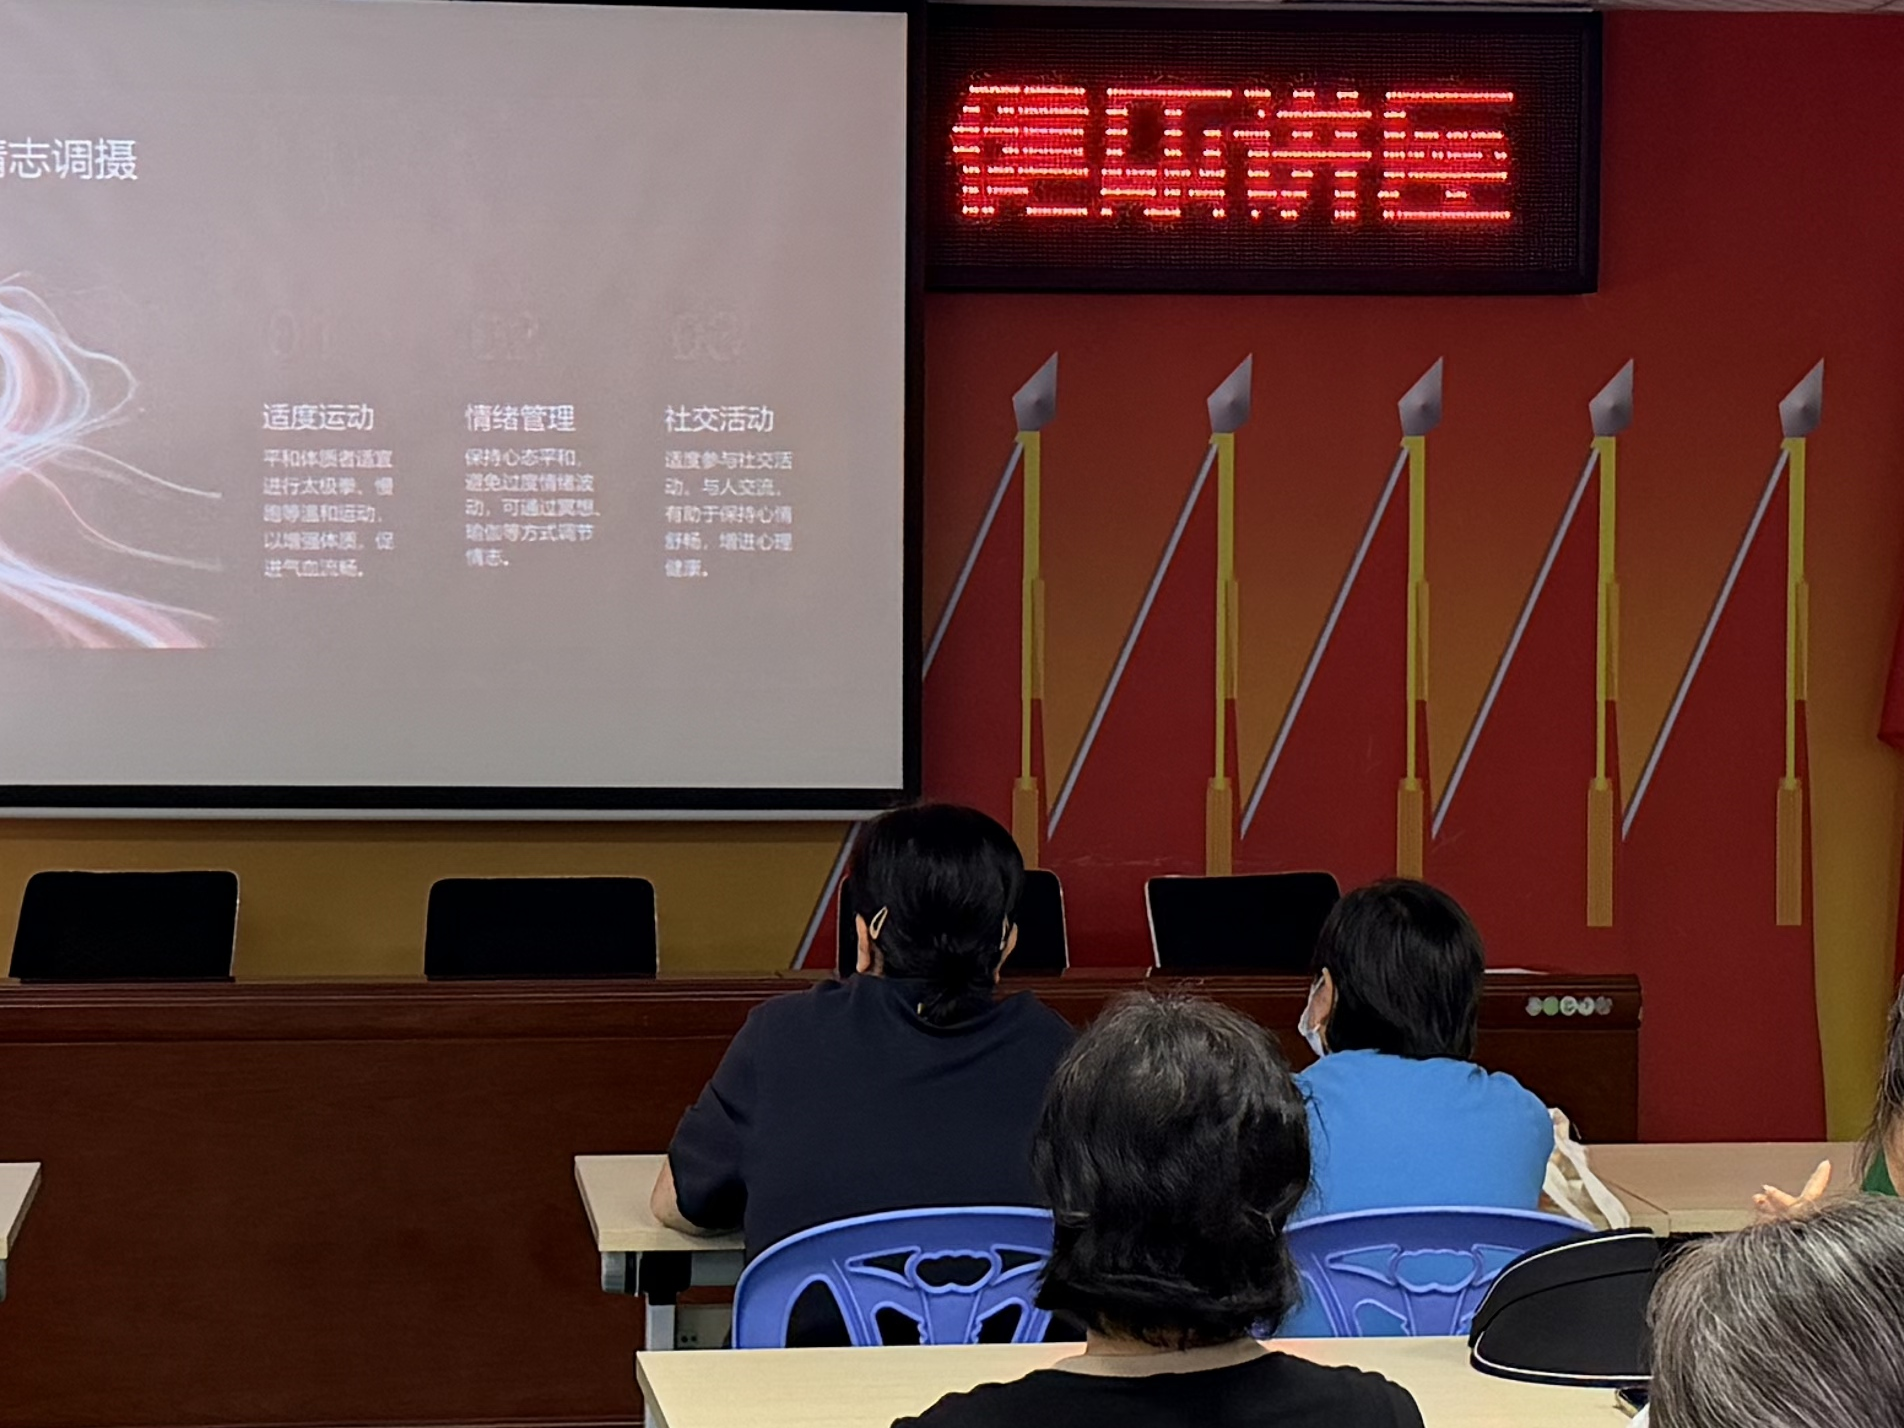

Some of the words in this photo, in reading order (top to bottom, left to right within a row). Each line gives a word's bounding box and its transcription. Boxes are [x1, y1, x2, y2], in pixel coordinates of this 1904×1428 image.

[262, 403, 375, 431] 适度运动
[464, 403, 576, 433] 情绪管理
[665, 404, 775, 434] 社交活动
